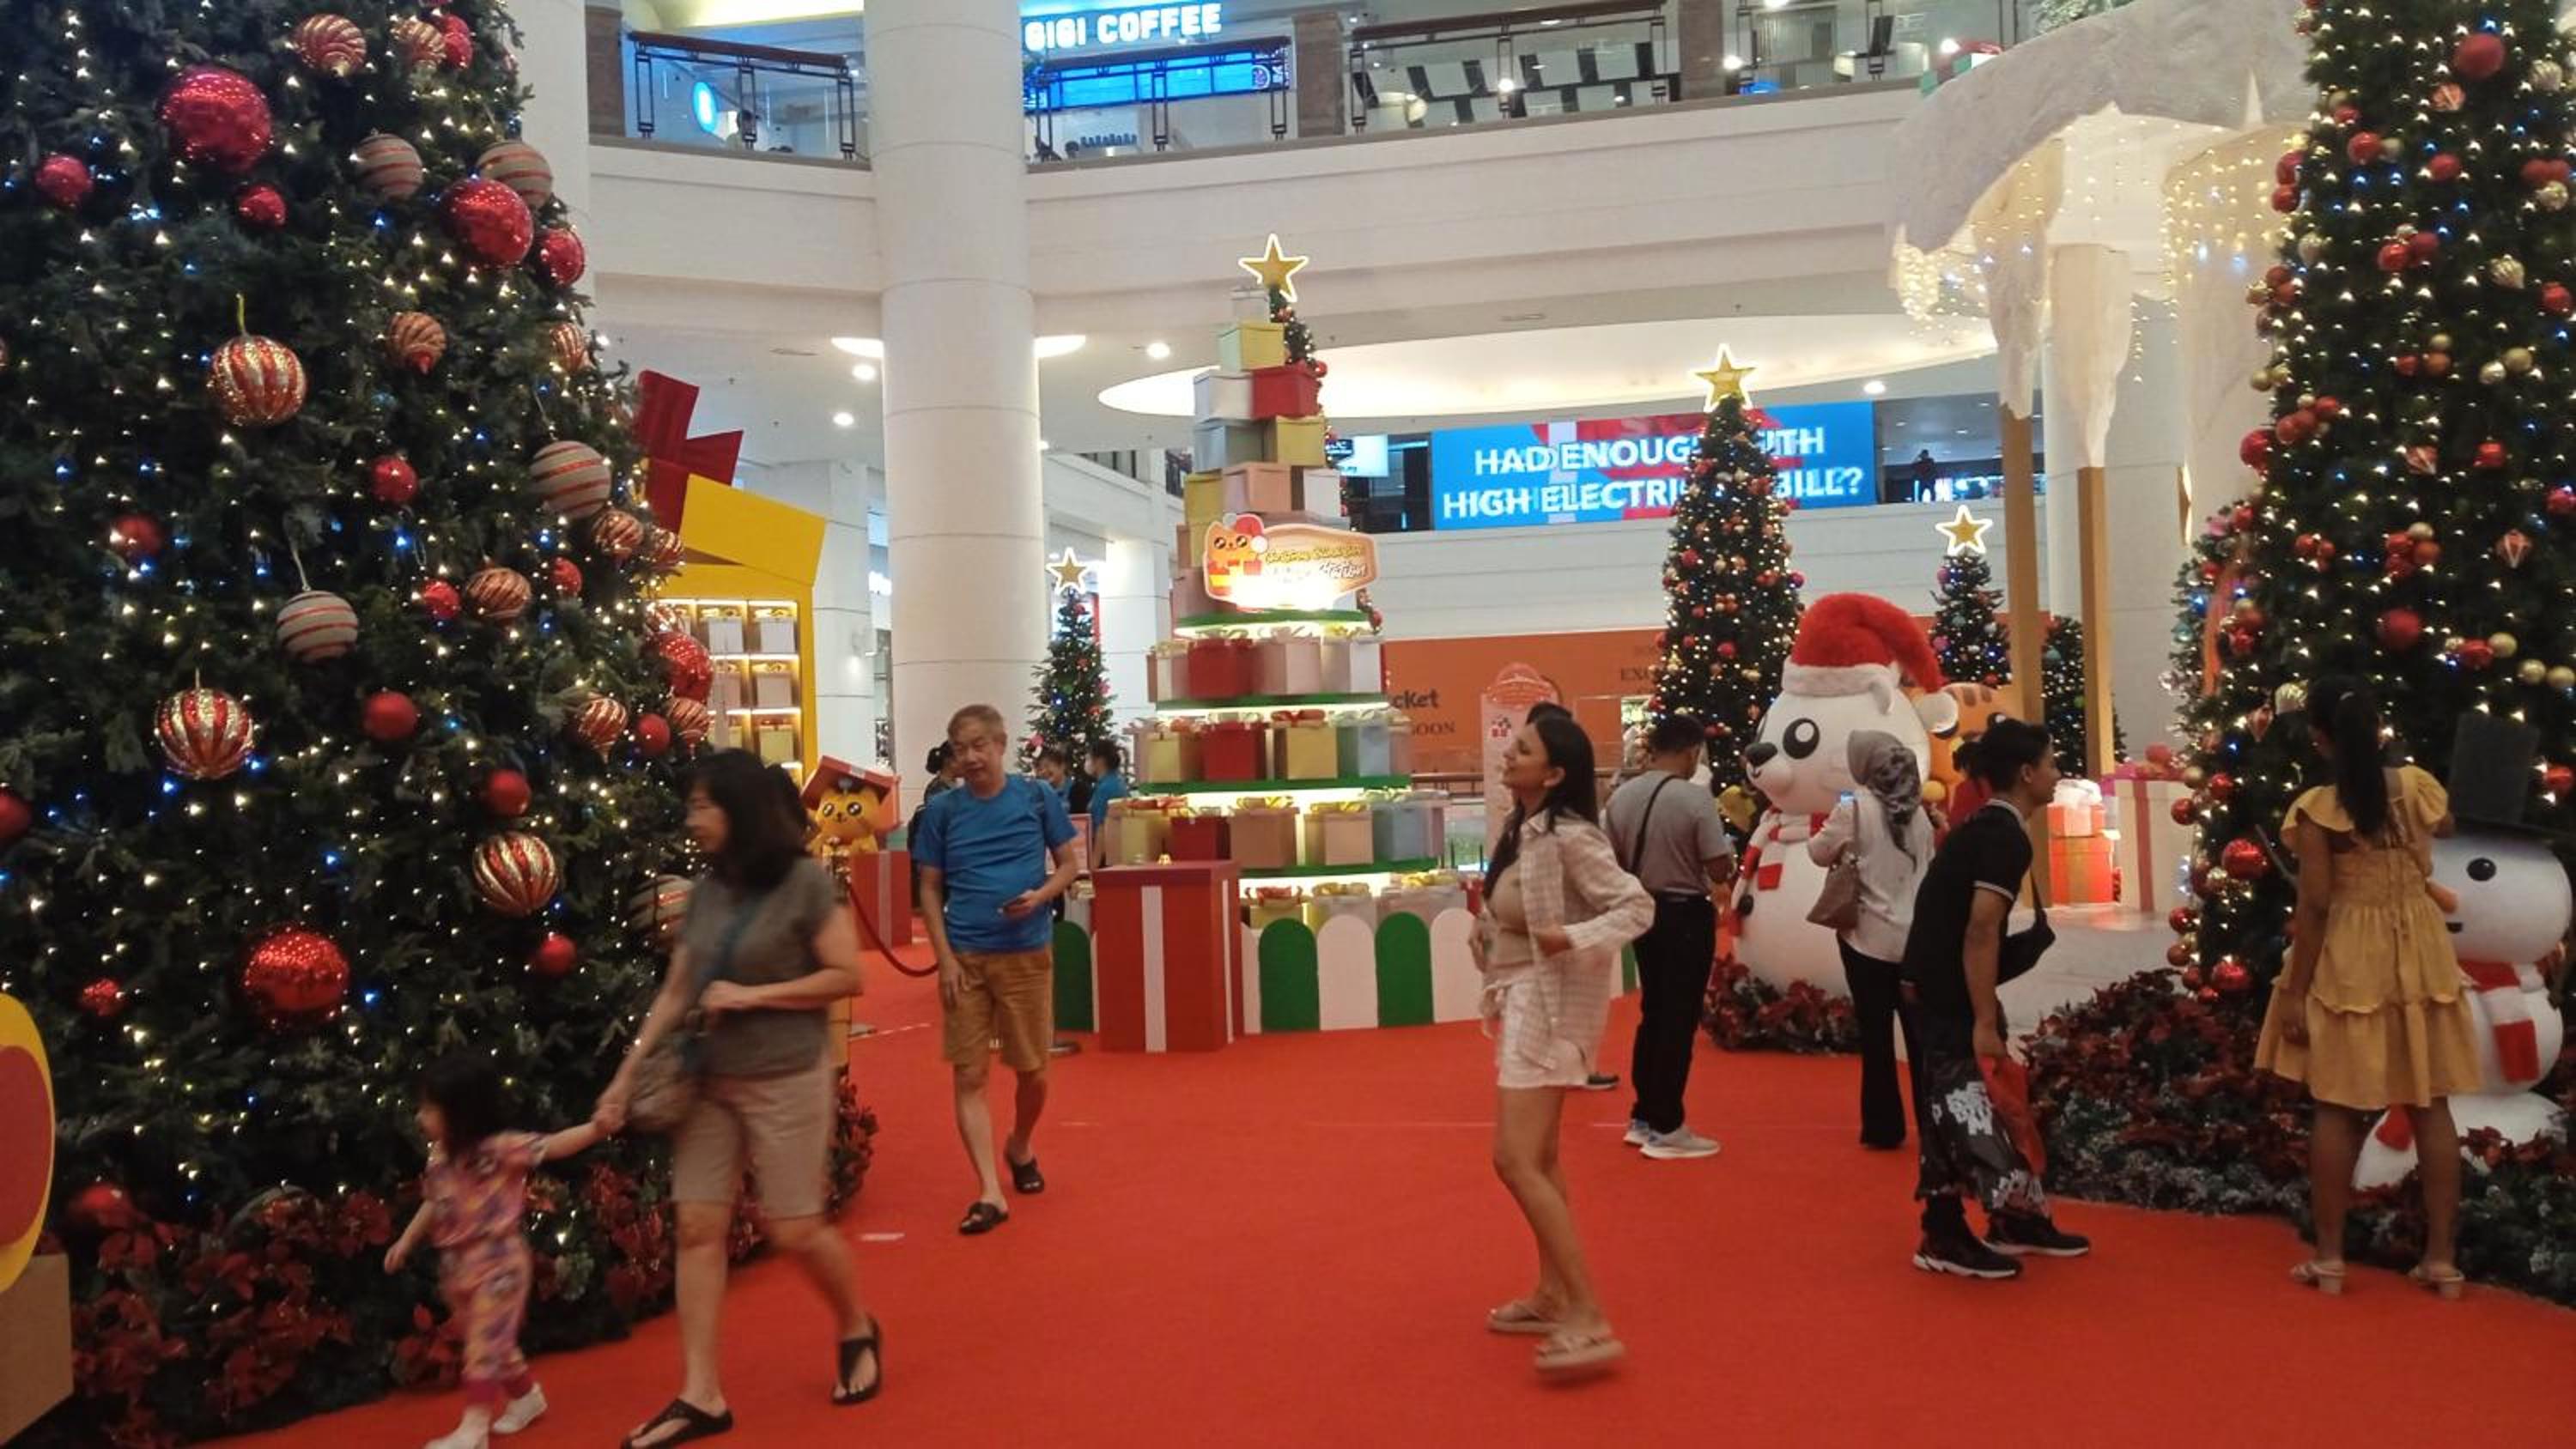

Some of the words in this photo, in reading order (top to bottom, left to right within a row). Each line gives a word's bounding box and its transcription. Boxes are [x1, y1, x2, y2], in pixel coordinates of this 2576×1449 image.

[1097, 3, 1222, 44] COFFEE
[1474, 444, 1558, 476] HAD
[1560, 435, 1700, 470] ENOUG
[1758, 427, 1825, 456] ITH
[1443, 487, 1530, 518] HIGH
[1541, 476, 1686, 512] ELECTRI
